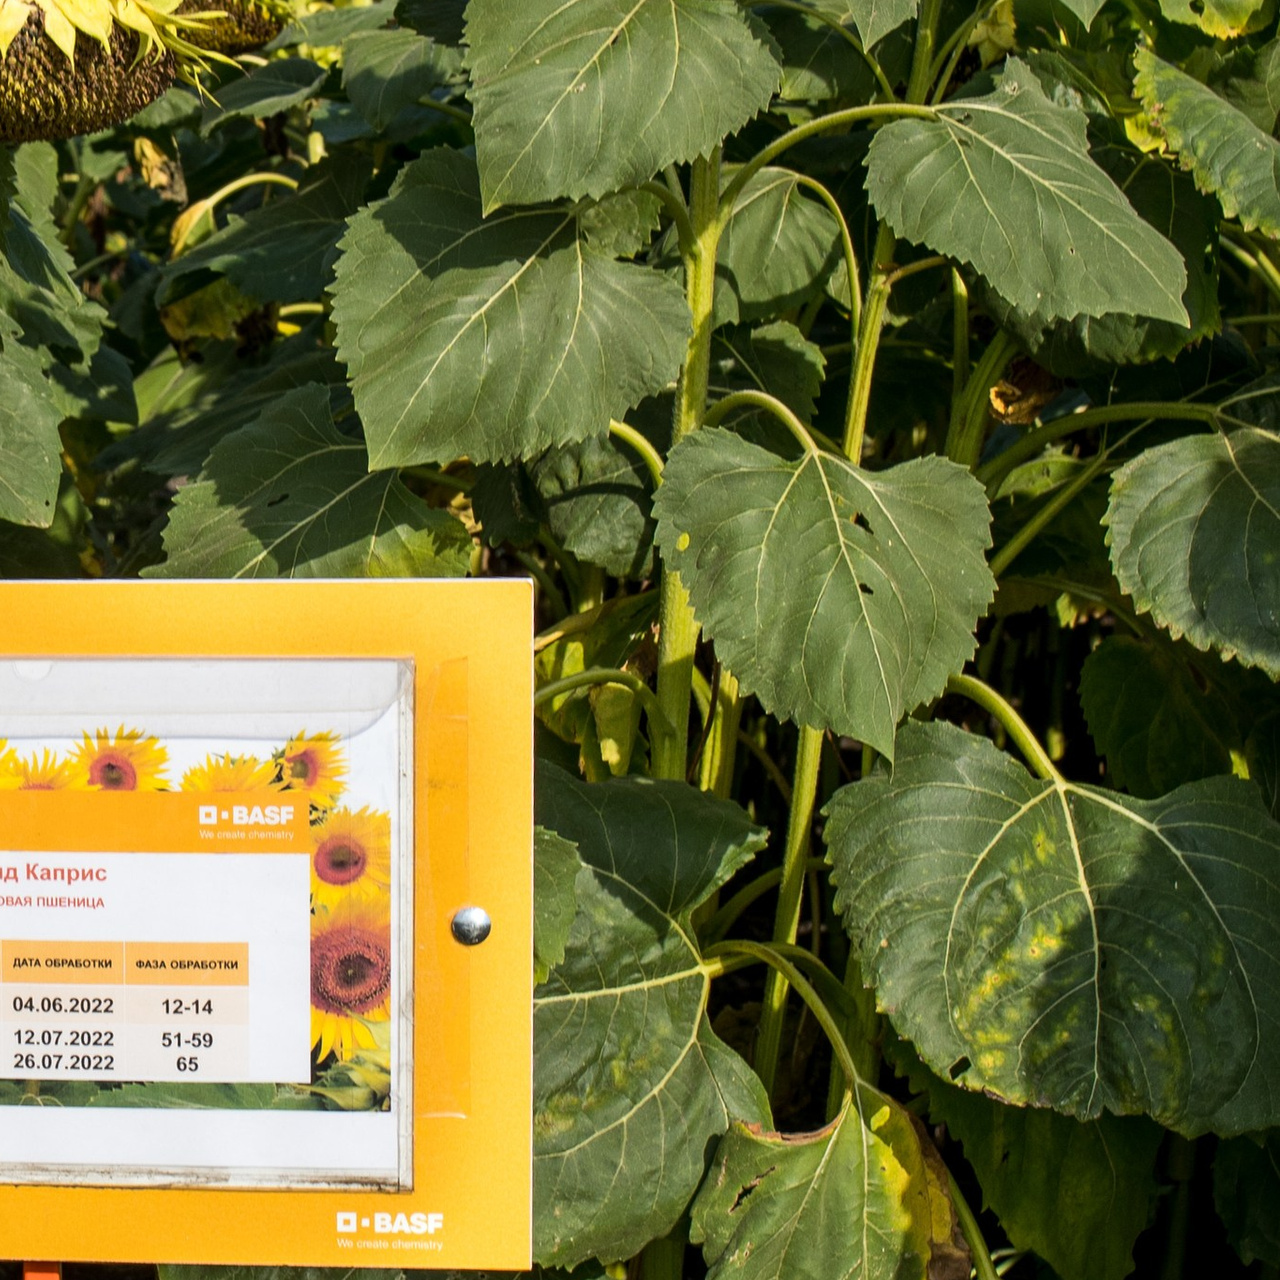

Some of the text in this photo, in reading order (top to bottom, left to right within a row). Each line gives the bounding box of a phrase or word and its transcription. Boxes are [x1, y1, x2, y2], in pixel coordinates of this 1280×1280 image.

[232, 805, 294, 825] BASF
[199, 829, 294, 842] We create chemistry
[25, 862, 107, 886] Каприс
[36, 896, 105, 910] ПШЕНИЦА
[12, 957, 113, 969] ДАТА ОБРАБОТКИ
[135, 959, 239, 971] ФАЗА ОБРАБОТКИ
[12, 995, 114, 1014] 04.06.2022
[161, 998, 214, 1015] 12-14
[13, 1028, 115, 1047] 12.07.2022
[161, 1031, 214, 1049] 51-59
[13, 1052, 115, 1071] 26.07.2022
[176, 1056, 199, 1073] 65
[374, 1212, 444, 1235] BASF
[337, 1238, 444, 1252] We create chemistry
